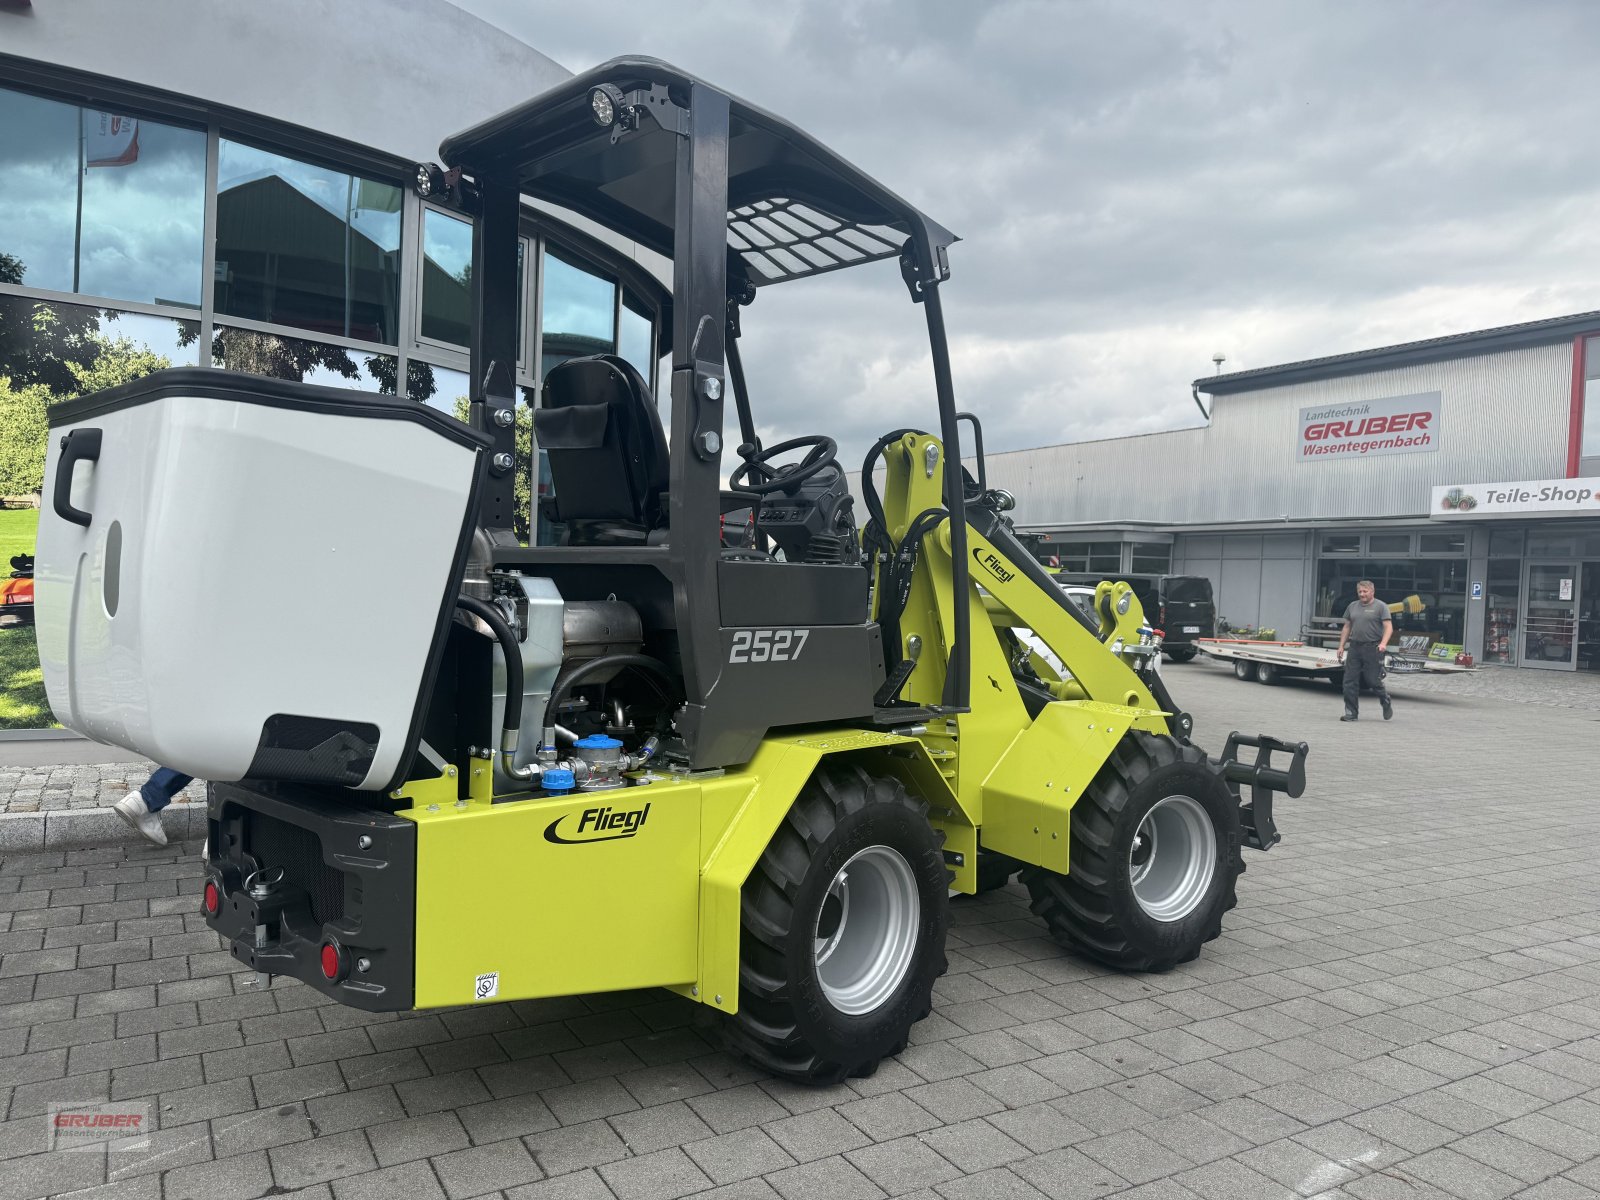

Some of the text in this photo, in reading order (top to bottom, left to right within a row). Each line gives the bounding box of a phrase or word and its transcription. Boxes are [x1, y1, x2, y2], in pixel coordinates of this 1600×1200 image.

[1305, 404, 1370, 421] Landtechnik
[1304, 411, 1432, 441] GRUBER
[1303, 433, 1430, 456] Wasentegernbach
[1486, 487, 1591, 504] Teile-Shop
[984, 554, 1015, 582] Fliegl
[1473, 583, 1481, 595] P
[729, 629, 810, 664] 2527
[577, 802, 651, 833] Fliegl
